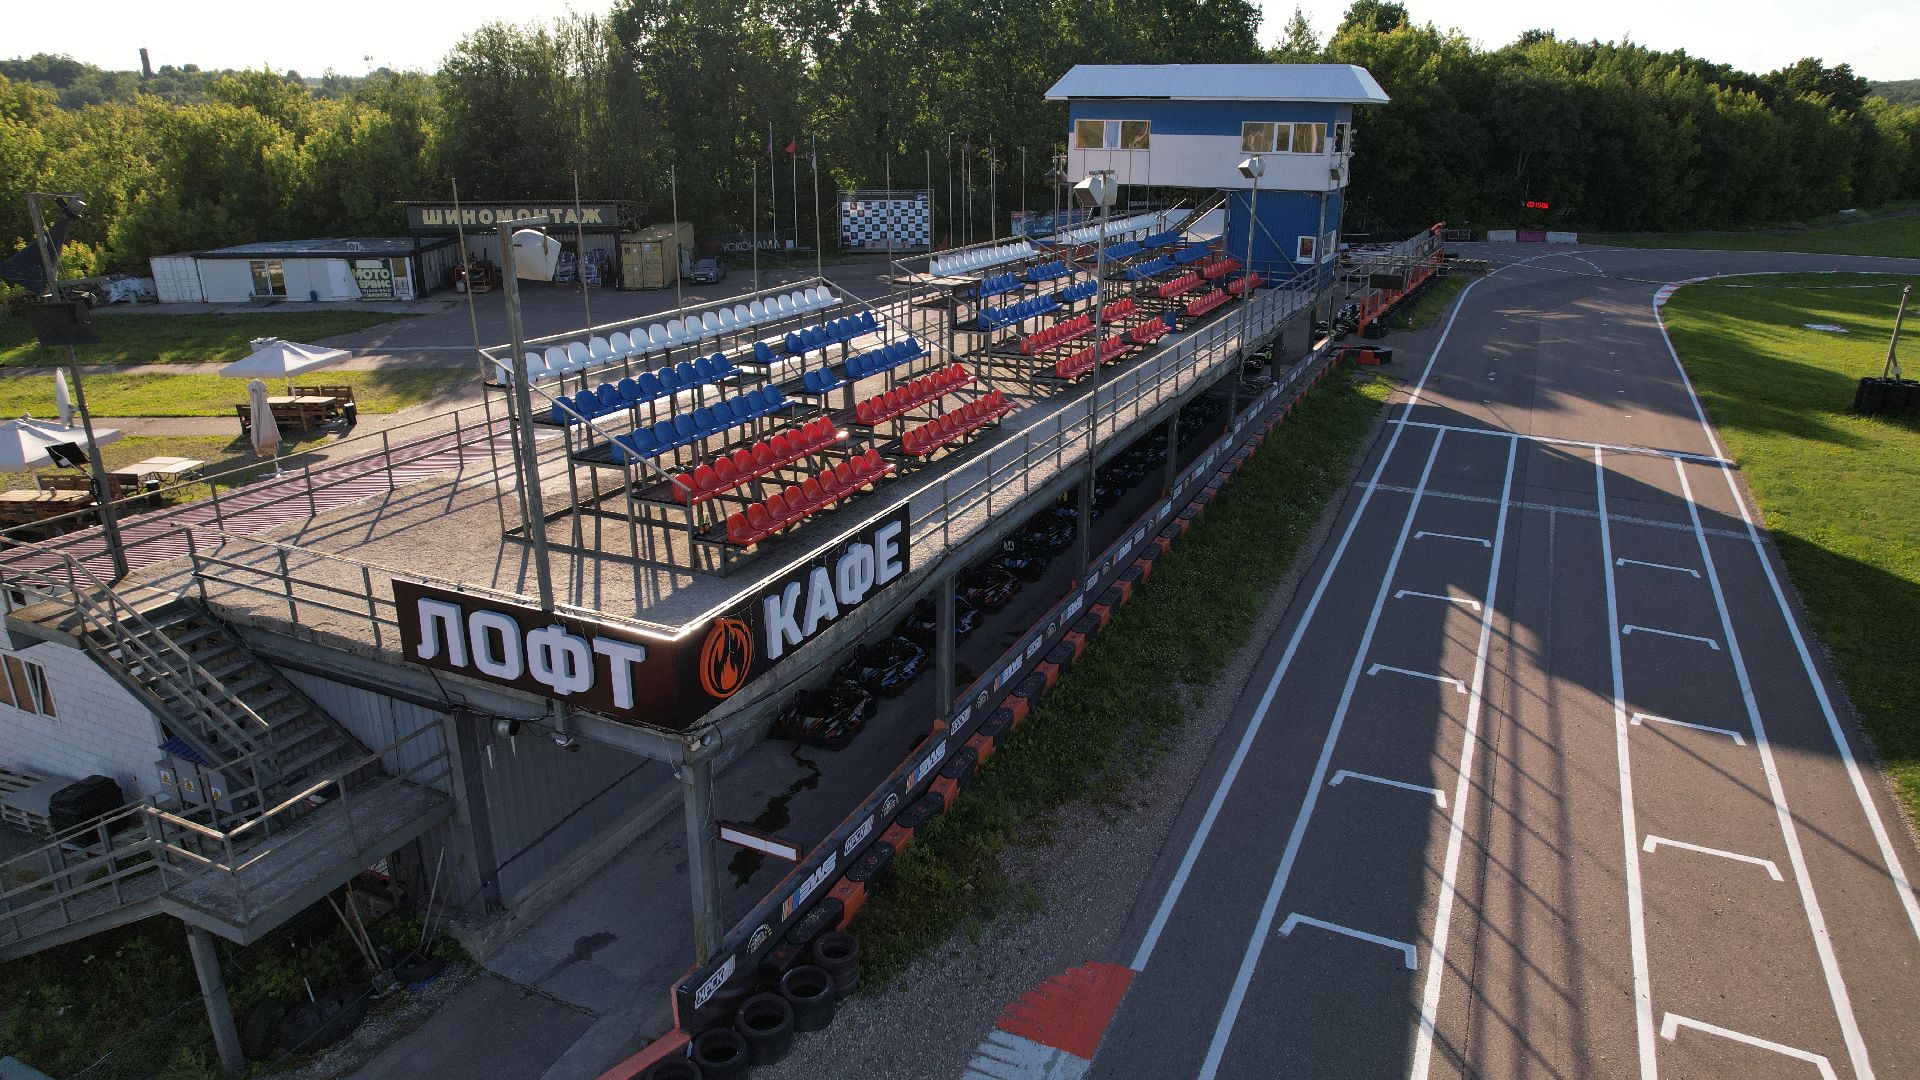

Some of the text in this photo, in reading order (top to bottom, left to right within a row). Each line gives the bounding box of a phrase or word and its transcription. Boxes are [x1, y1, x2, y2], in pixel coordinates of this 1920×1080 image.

[422, 208, 603, 225] ШИНОМОНТАЖ
[721, 239, 781, 252] YOKOHAMA
[352, 268, 390, 280] МОТО
[359, 279, 391, 288] ЕРВИС
[763, 520, 903, 660] КАФЕ
[416, 597, 646, 710] ЛОФТ
